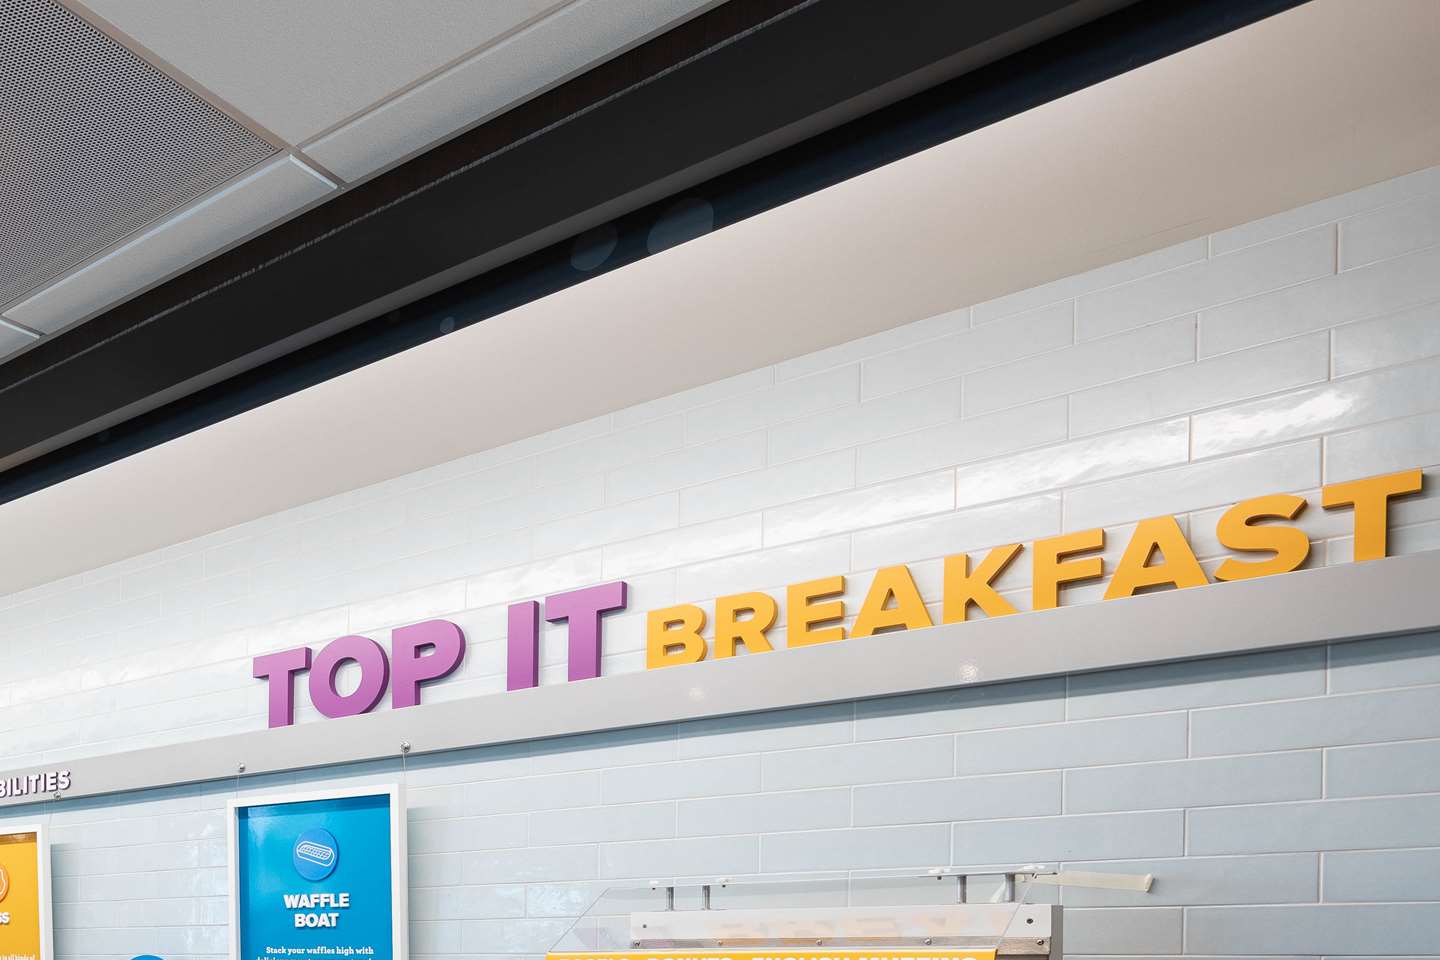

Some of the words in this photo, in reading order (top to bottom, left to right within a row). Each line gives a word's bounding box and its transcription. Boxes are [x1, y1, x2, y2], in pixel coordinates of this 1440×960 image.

[253, 619, 467, 729] TOP
[507, 581, 628, 692] IT
[646, 468, 1423, 669] BREAKFAST
[283, 893, 350, 909] WAFFLE
[294, 912, 340, 928] BOAT
[266, 946, 286, 954] Stack
[287, 947, 305, 956] your
[306, 946, 335, 955] waffles
[336, 946, 354, 956] high
[356, 946, 374, 955] with
